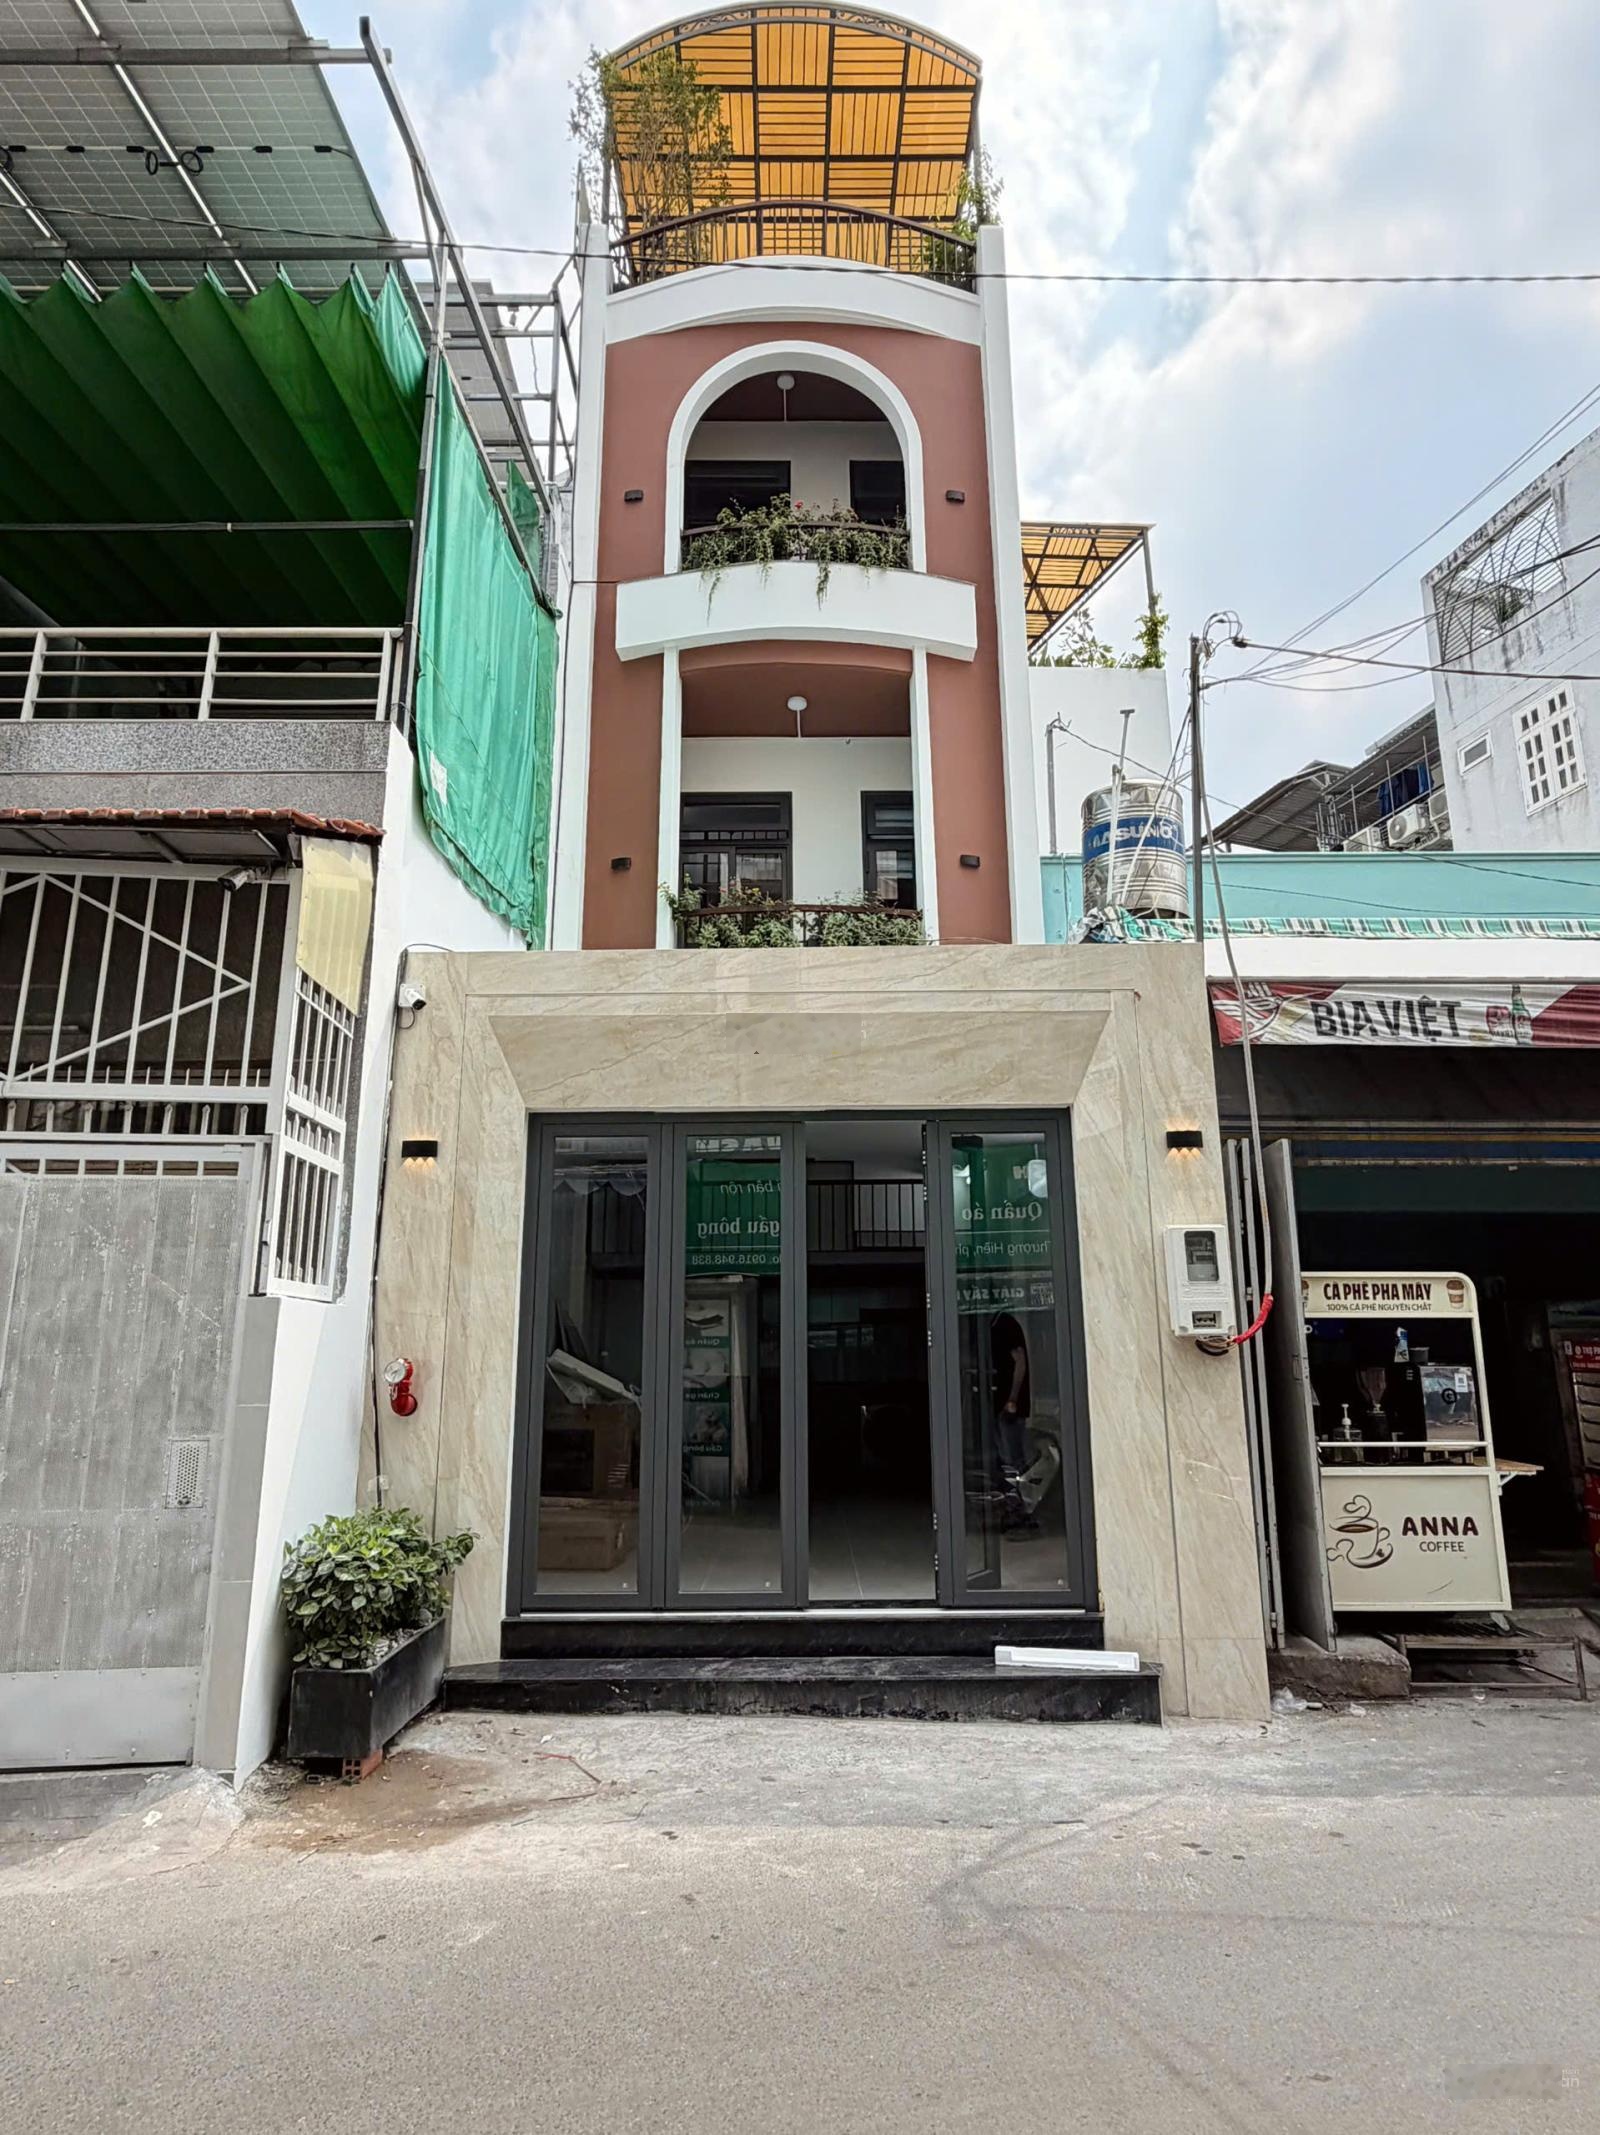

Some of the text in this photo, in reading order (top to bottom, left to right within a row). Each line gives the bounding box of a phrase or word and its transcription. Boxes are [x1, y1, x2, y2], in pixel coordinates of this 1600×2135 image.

[1311, 1000, 1378, 1036] BIA
[1376, 995, 1462, 1042] VIỆT
[1342, 1281, 1370, 1300] PHÊ
[1371, 1283, 1400, 1300] PHA
[1326, 1303, 1349, 1311] 100%
[1401, 1516, 1479, 1536] ANNA
[1419, 1541, 1465, 1552] COFFEE
